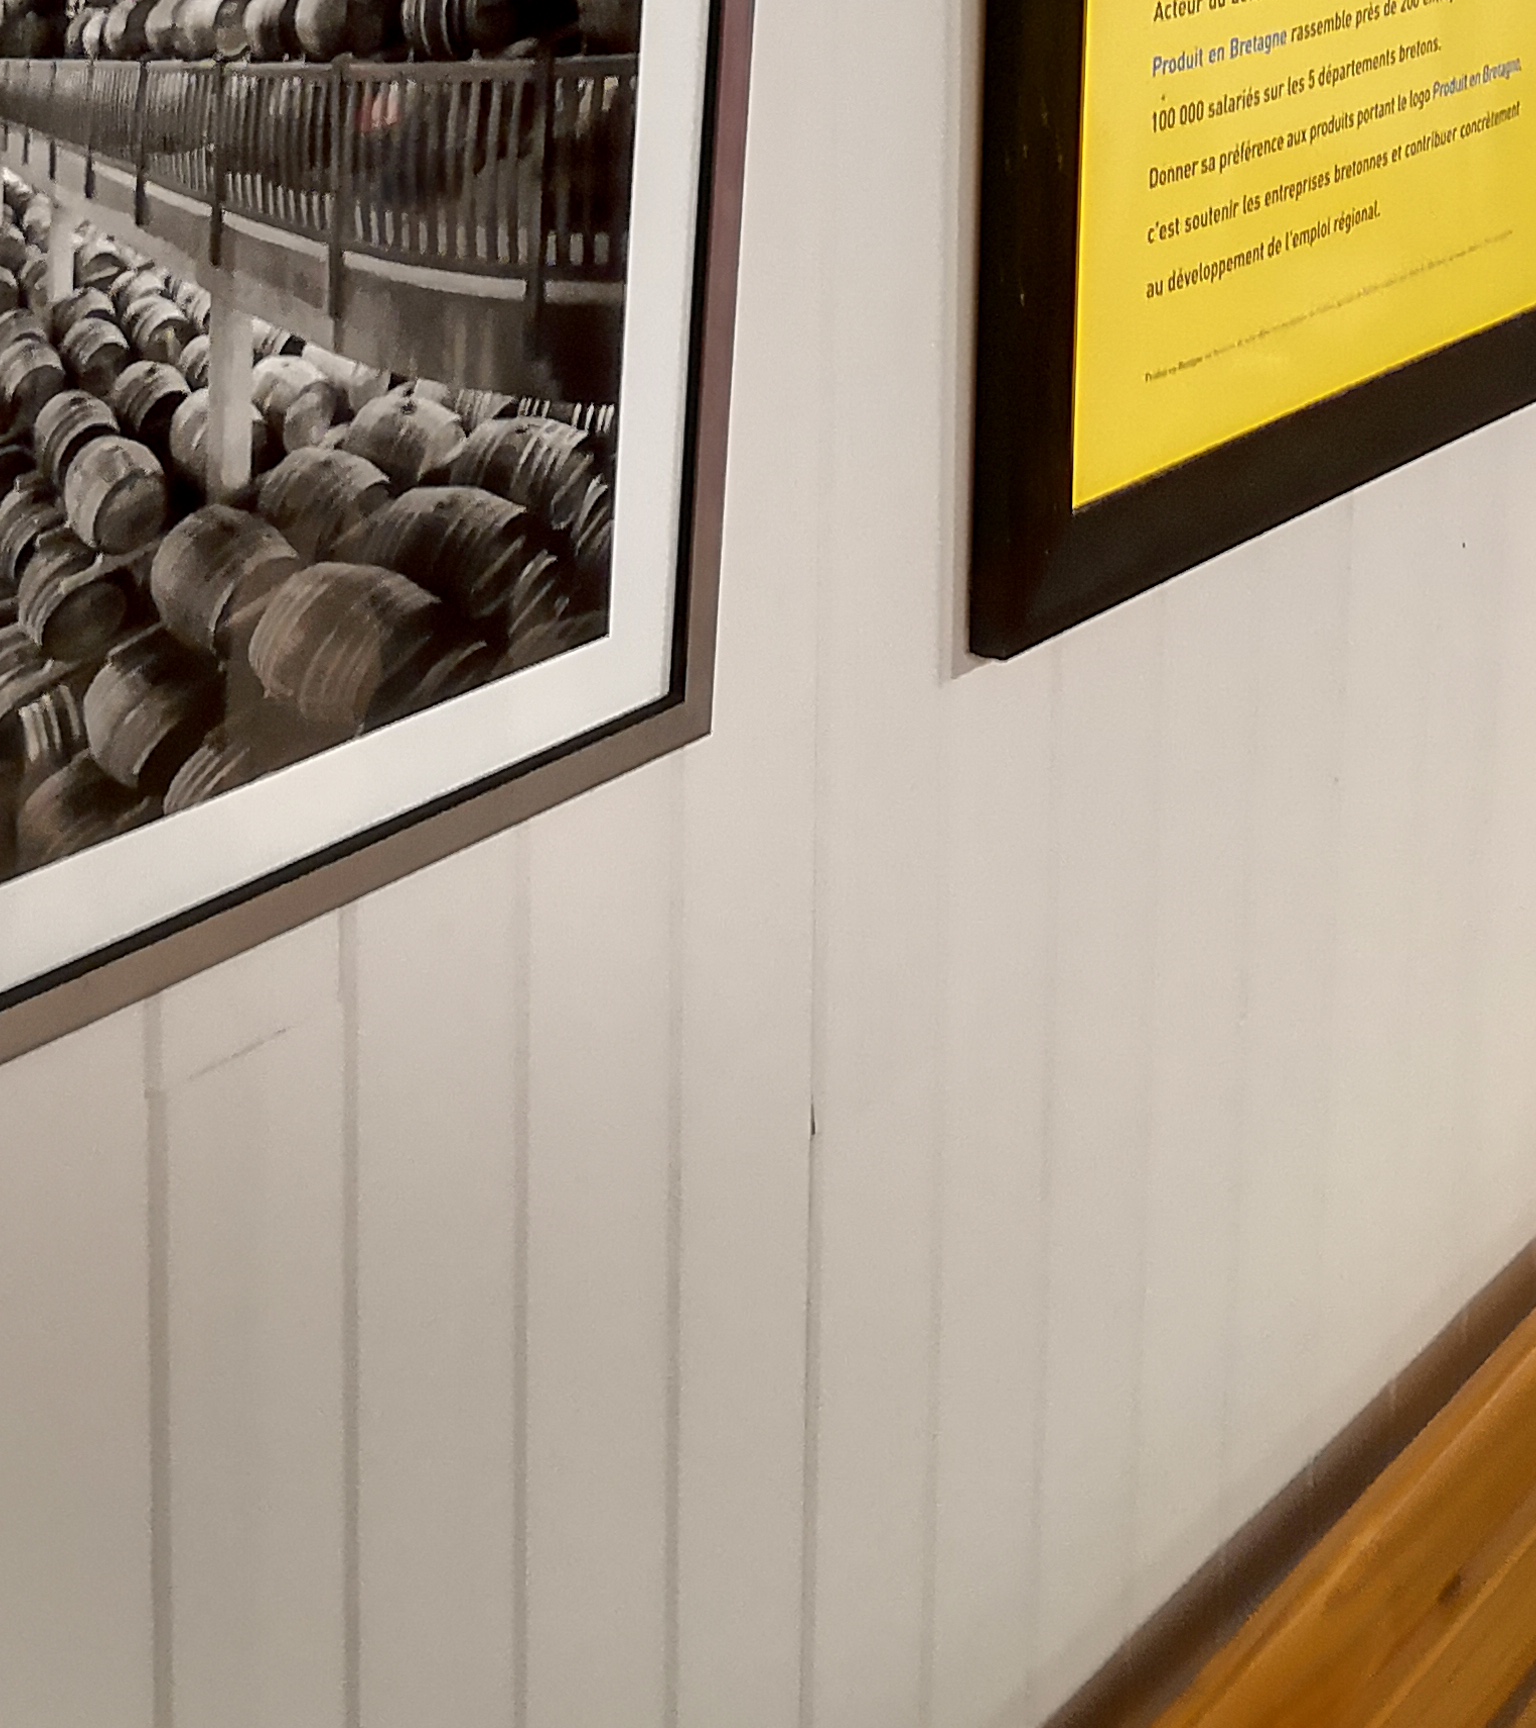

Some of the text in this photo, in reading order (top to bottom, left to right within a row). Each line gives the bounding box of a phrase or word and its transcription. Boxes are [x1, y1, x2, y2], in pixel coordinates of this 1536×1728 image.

[1152, 47, 1203, 78] Produit
[1209, 46, 1225, 64] en
[1229, 29, 1287, 59] Bretagne
[1291, 10, 1352, 42] rassemble
[1356, 2, 1380, 29] près
[1152, 37, 1441, 133] 100 000 salariés sur les 5 départements bretons.
[1147, 101, 1520, 244] c'est soutenir les entreprises bretonnes et contribuer concrètement
[1149, 161, 1199, 189] Donner
[1201, 156, 1215, 174] sa
[1219, 135, 1284, 173] préférence
[1287, 129, 1307, 148] aux
[1309, 113, 1354, 145] produits
[1357, 97, 1395, 129] portant
[1397, 94, 1407, 112] le
[1409, 89, 1431, 110] logo
[1432, 74, 1467, 99] Produit
[1469, 72, 1481, 88] en
[1146, 200, 1380, 298] au développement de l'emploi régional.
